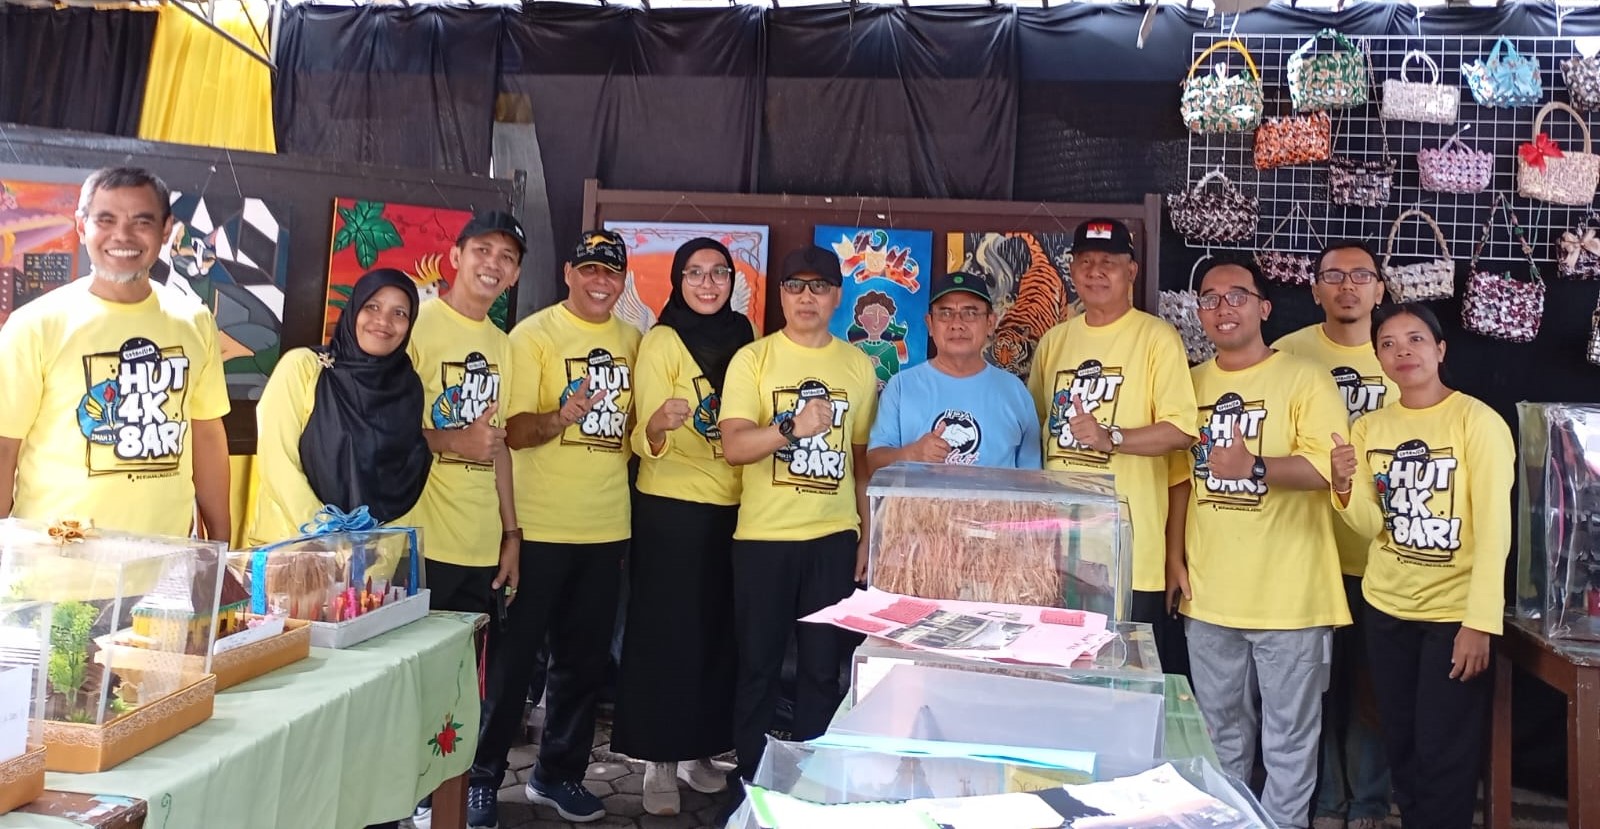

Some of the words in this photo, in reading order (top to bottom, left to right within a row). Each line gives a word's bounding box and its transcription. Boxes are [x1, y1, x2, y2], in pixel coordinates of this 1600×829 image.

[118, 357, 189, 394] HUT
[461, 372, 500, 402] HUT
[588, 365, 630, 391] HUT
[1070, 375, 1124, 403] HUT
[118, 392, 169, 426] 4K
[1388, 458, 1457, 490] HUT
[1389, 487, 1433, 519] 4K
